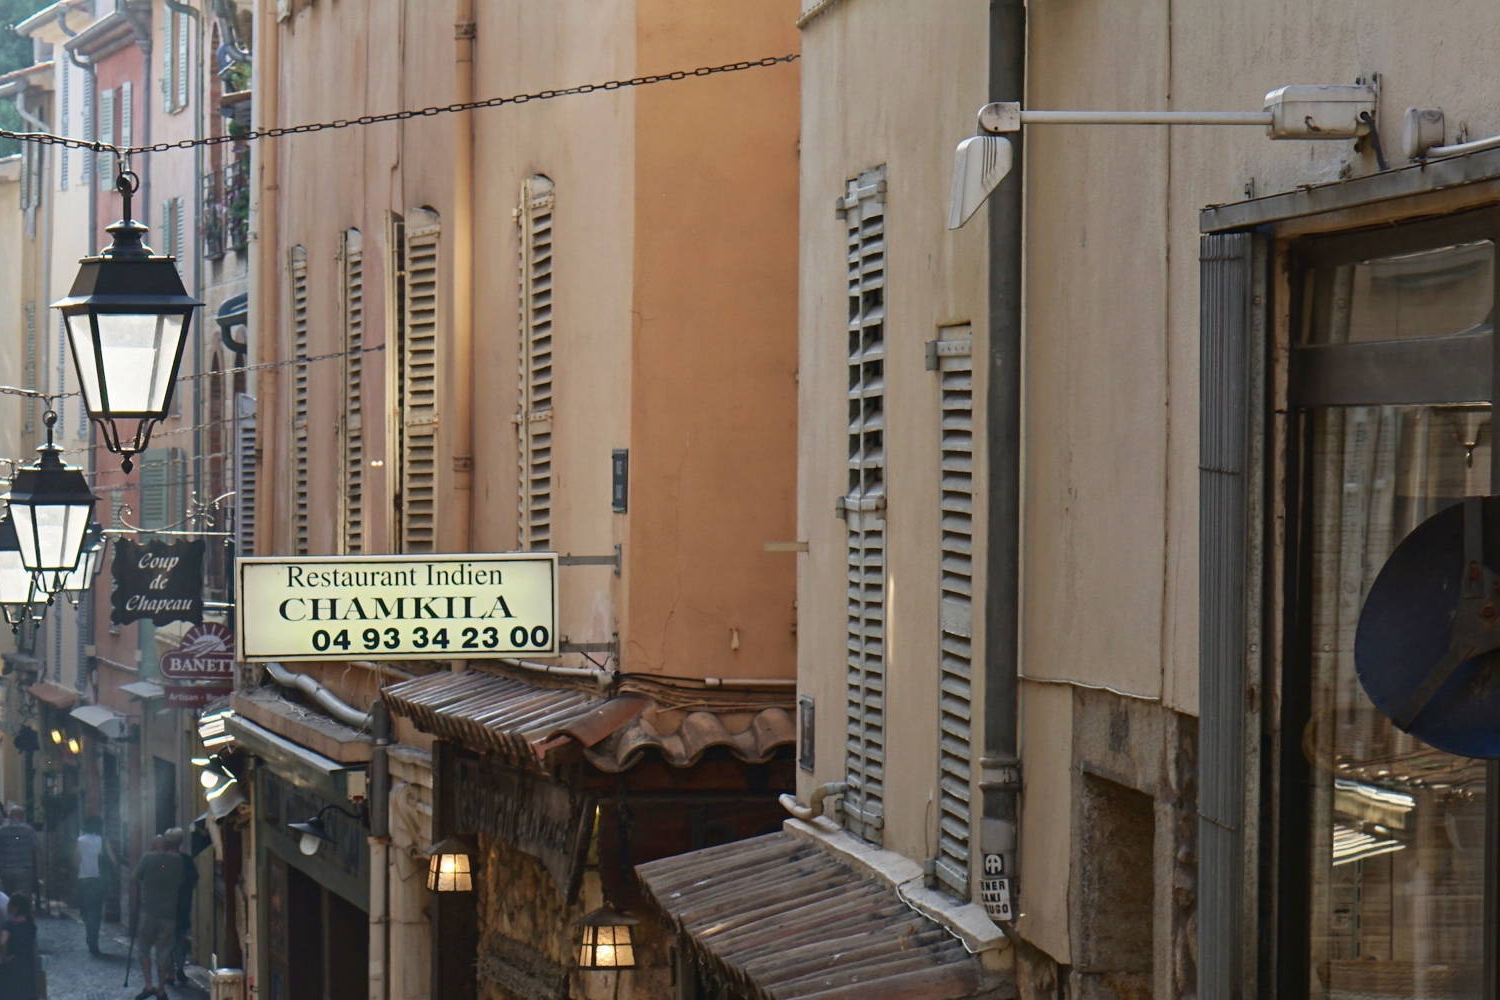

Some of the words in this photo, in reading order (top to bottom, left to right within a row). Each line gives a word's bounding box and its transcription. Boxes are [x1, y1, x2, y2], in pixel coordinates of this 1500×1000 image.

[138, 553, 180, 572] Coup
[149, 574, 169, 590] de
[286, 564, 417, 588] Restaurant
[426, 563, 504, 587] Indien
[125, 594, 193, 614] Chapeau
[279, 595, 517, 622] CHAMKILA
[311, 629, 351, 651] 04
[362, 627, 400, 650] 93
[412, 626, 450, 649] 34
[461, 626, 499, 648] 23
[510, 625, 549, 648] 00
[170, 658, 235, 672] BANETT
